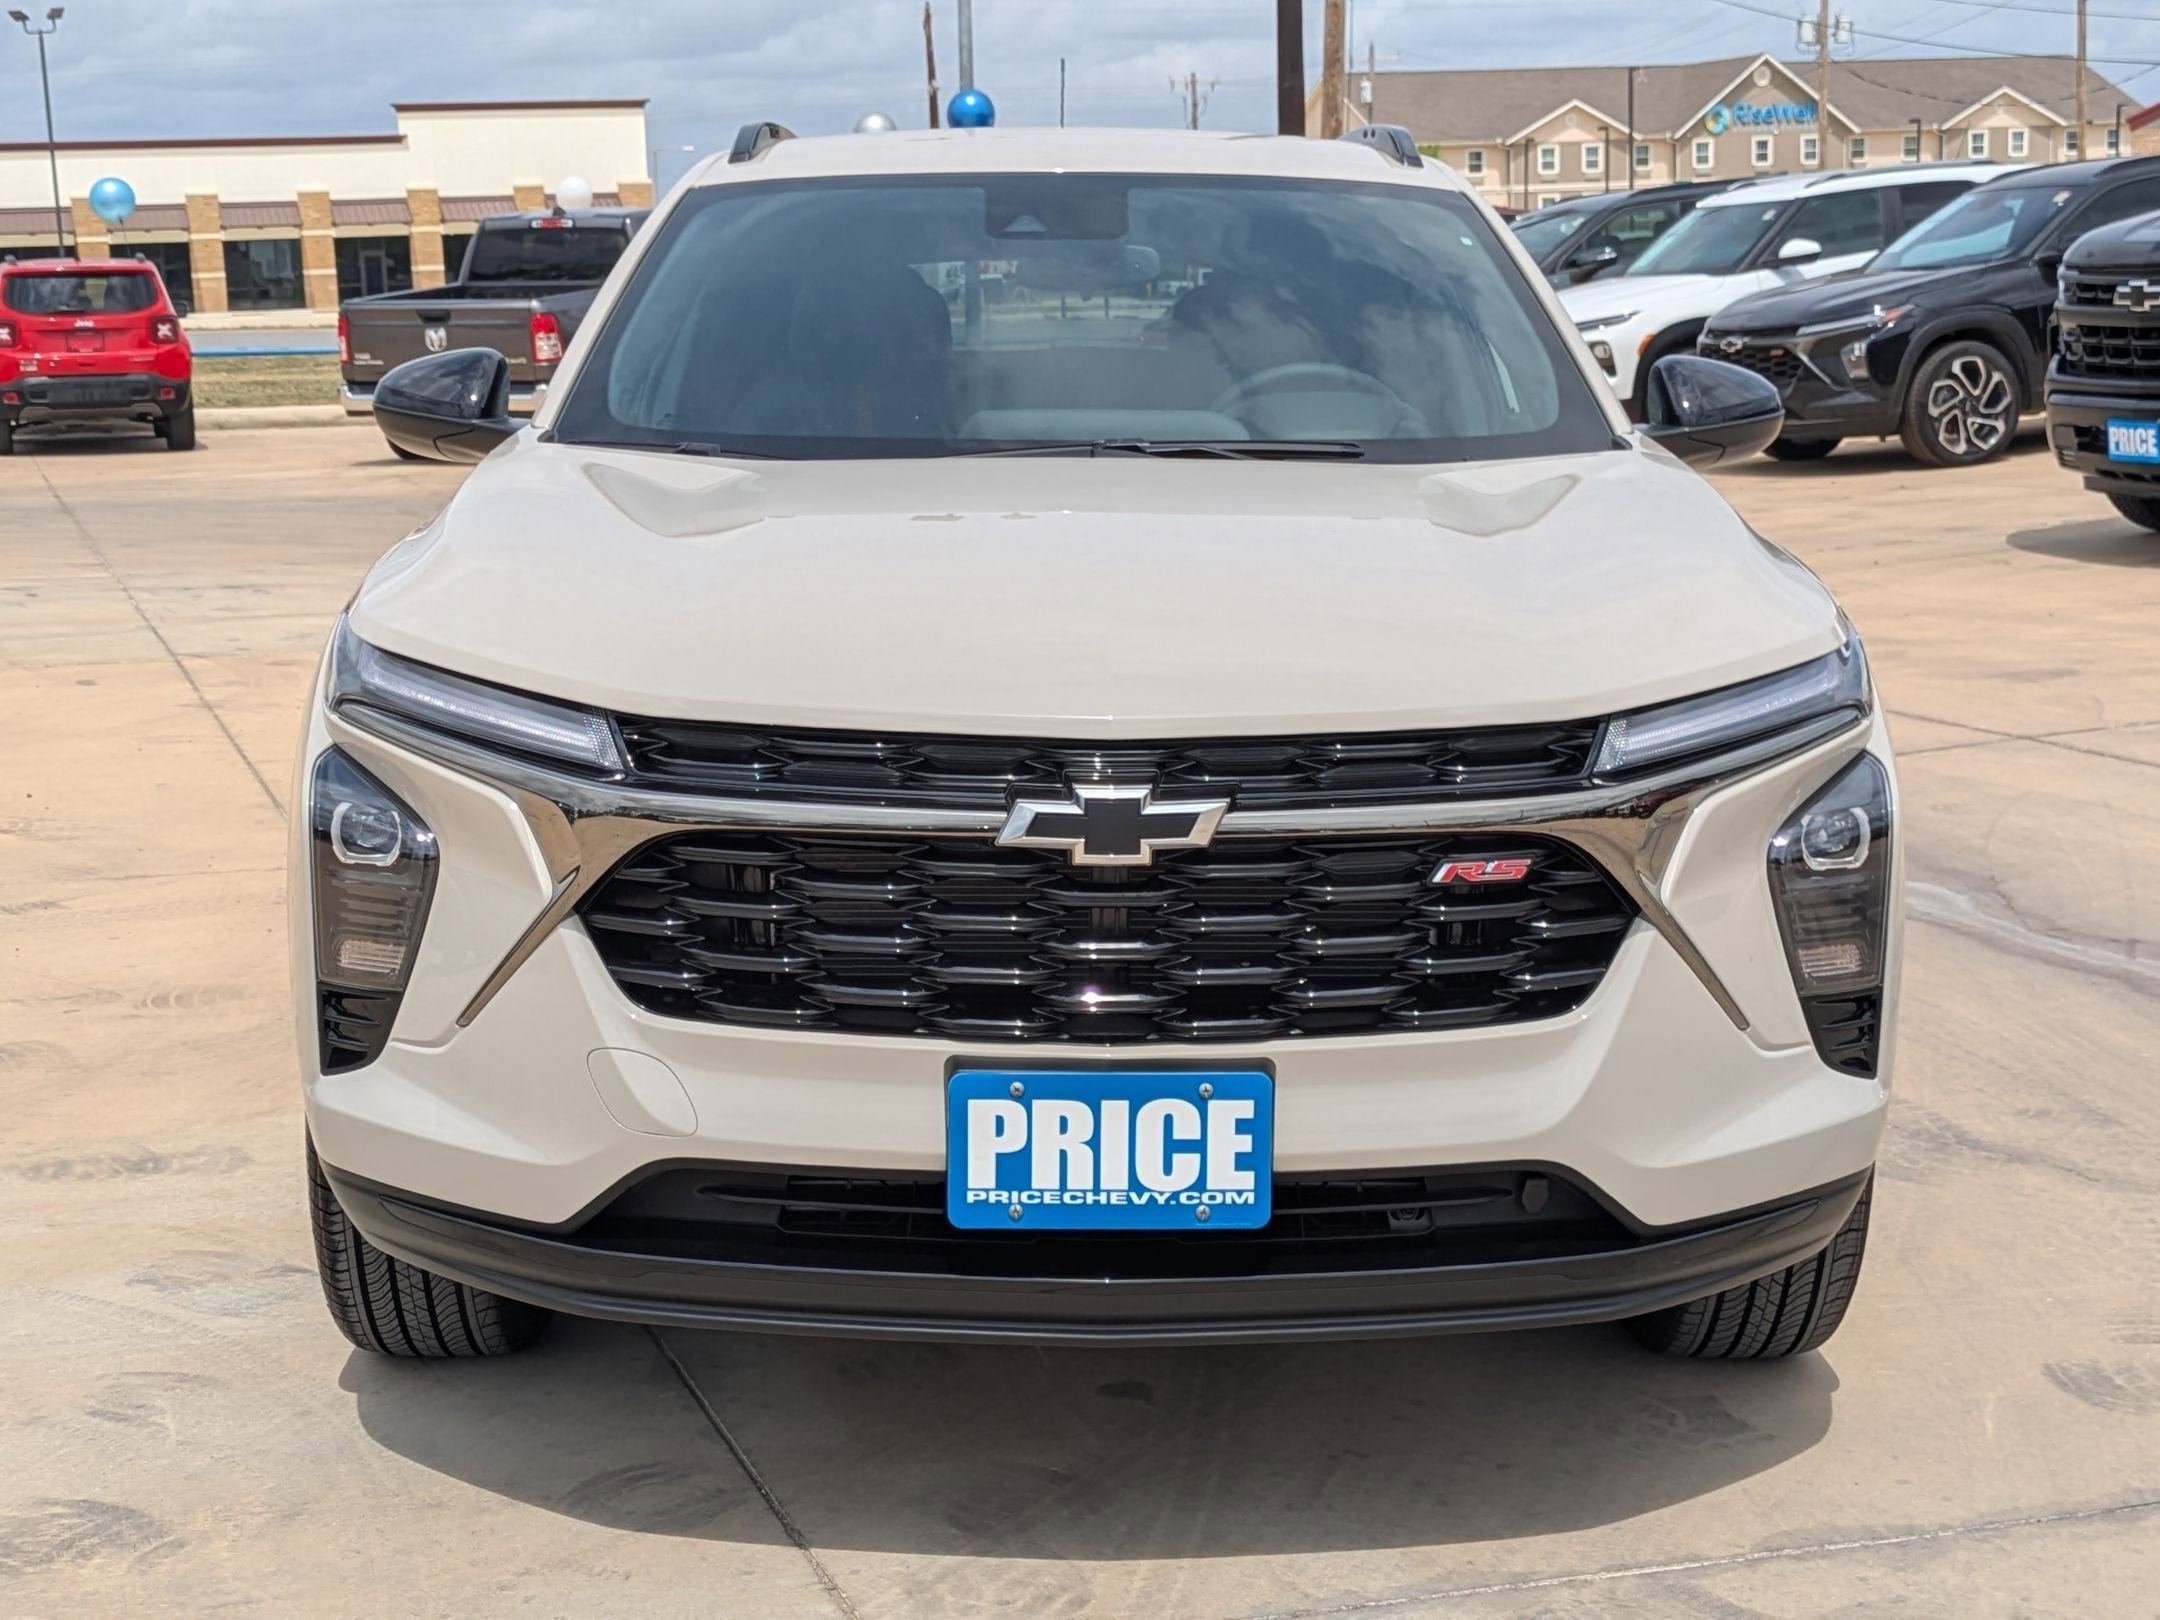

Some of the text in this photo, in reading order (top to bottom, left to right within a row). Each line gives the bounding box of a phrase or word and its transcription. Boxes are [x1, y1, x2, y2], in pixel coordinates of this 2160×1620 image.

[2108, 426, 2158, 453] PRICE
[1432, 859, 1531, 882] RS
[967, 1098, 1255, 1192] PRICE
[967, 1190, 1255, 1205] PRICECHEVY.COM
